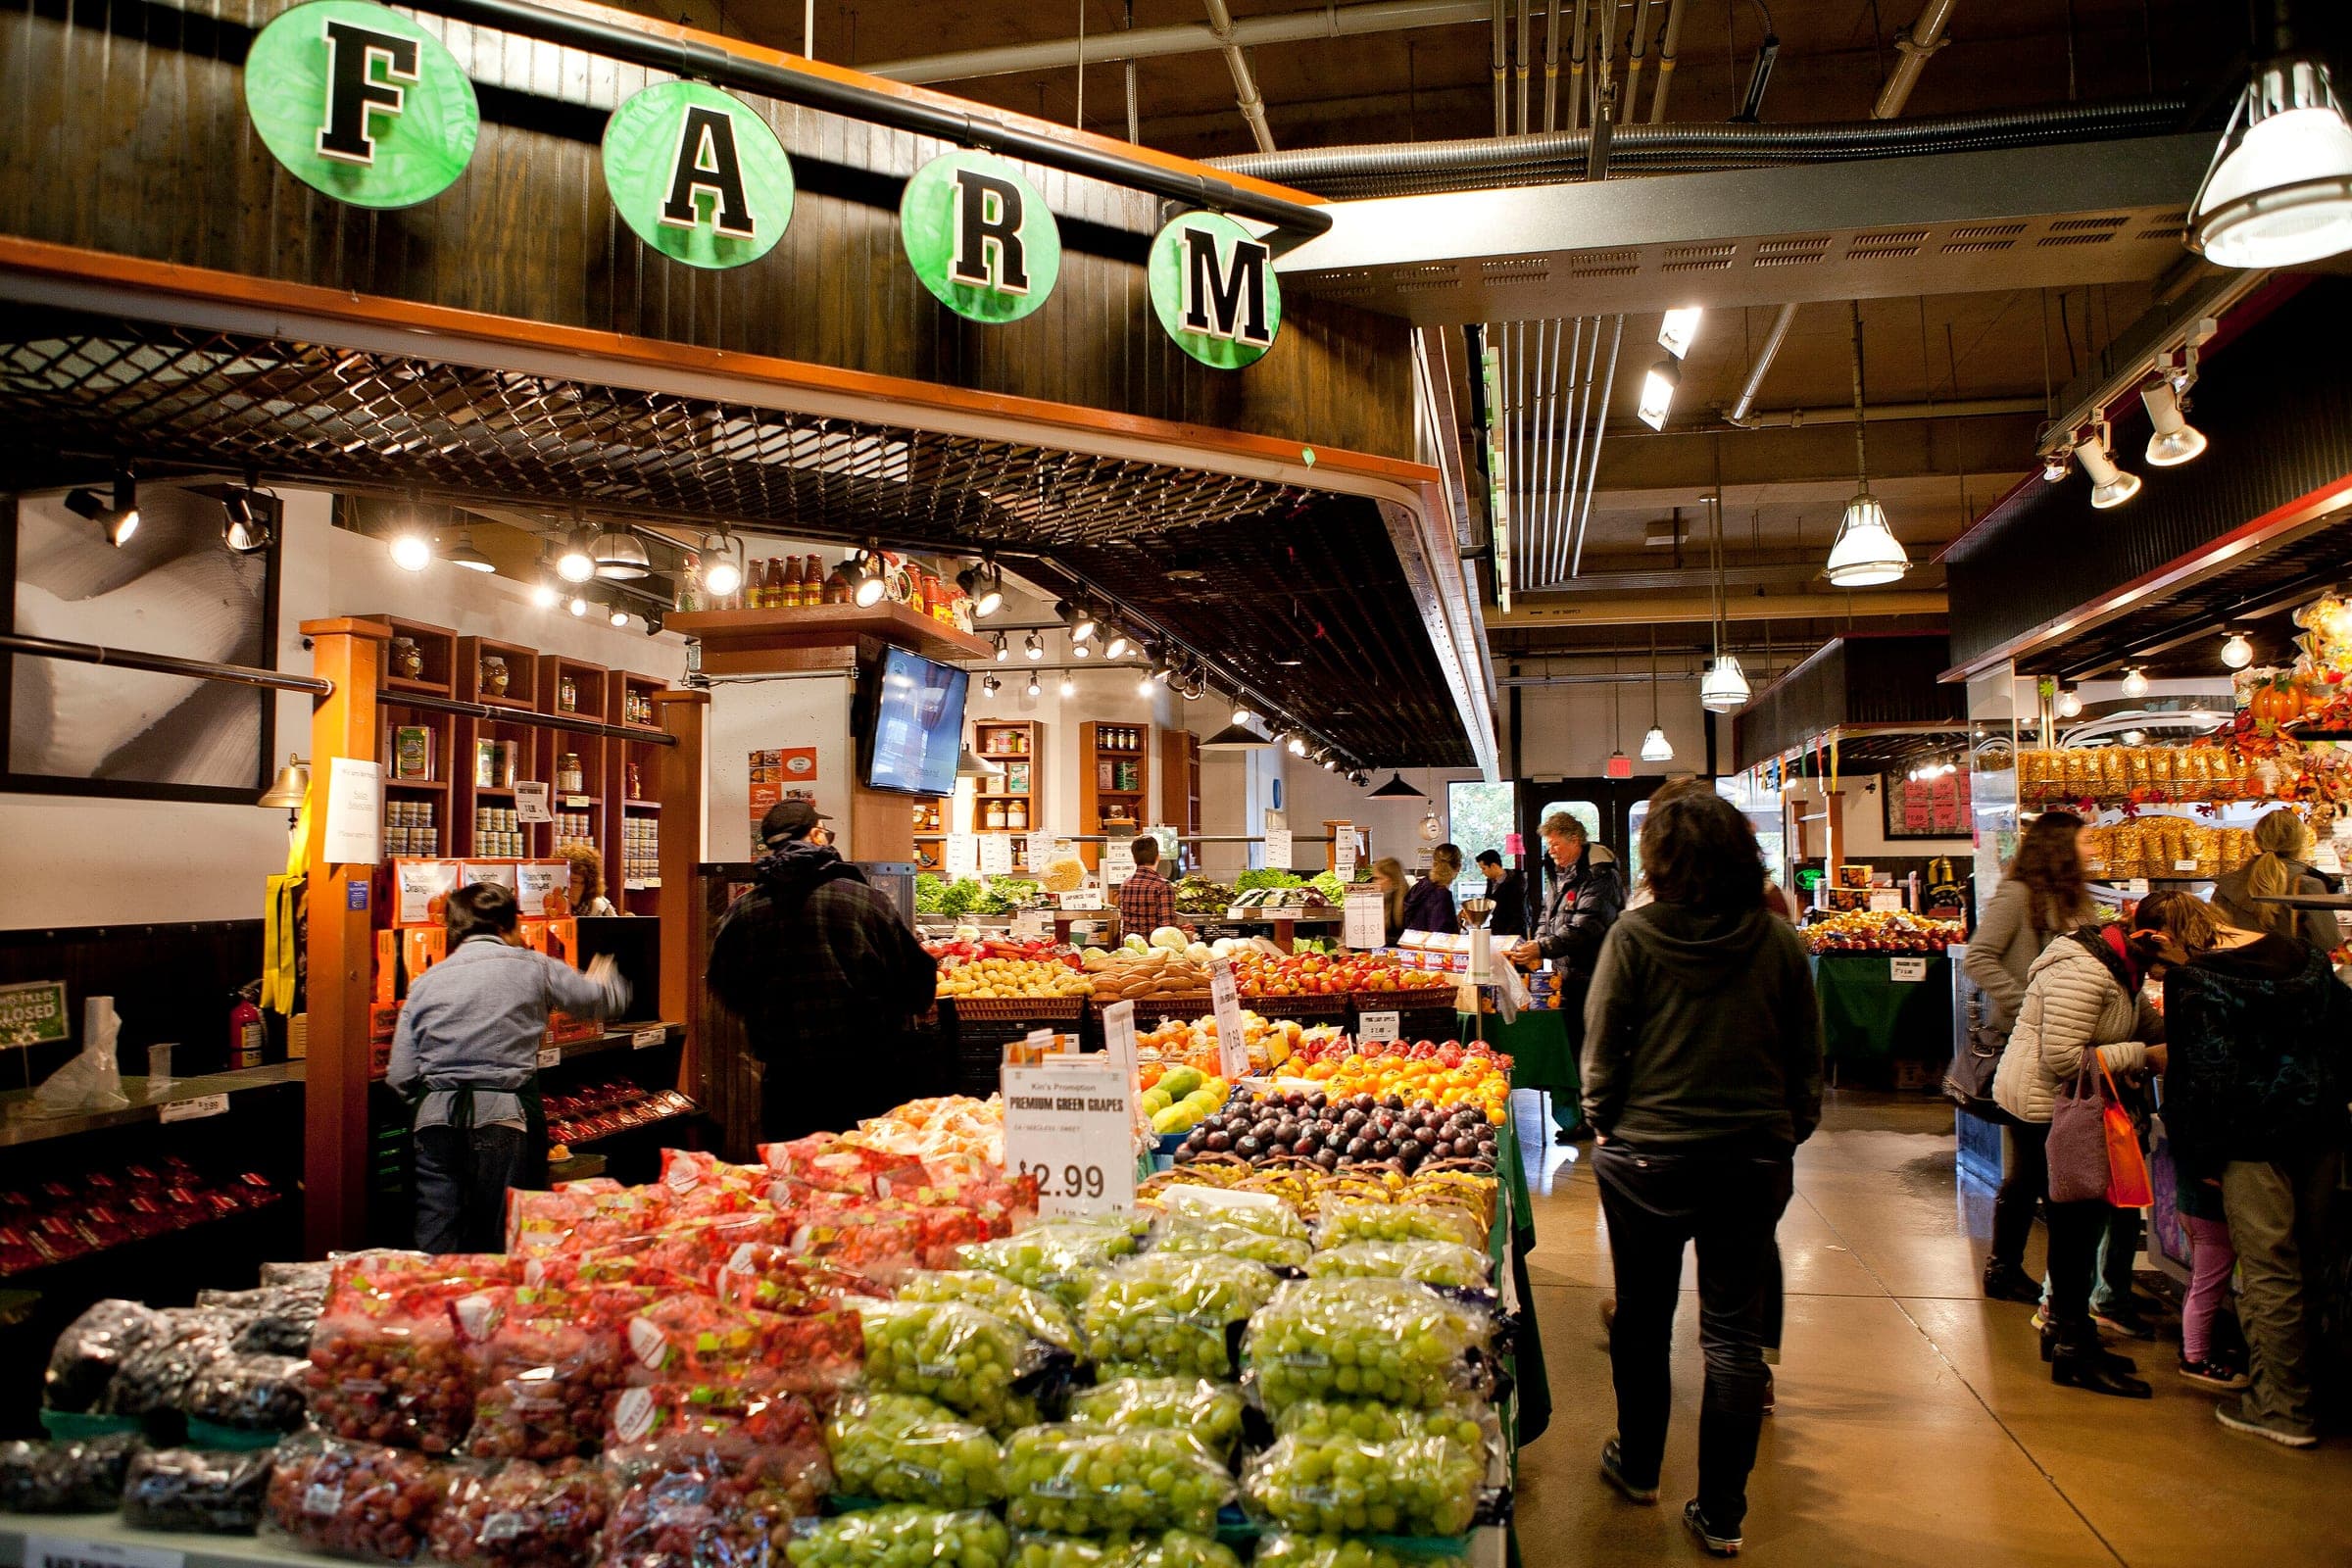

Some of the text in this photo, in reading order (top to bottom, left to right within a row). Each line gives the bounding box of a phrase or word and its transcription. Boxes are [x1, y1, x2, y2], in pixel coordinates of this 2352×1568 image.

[0, 1004, 56, 1024] LOSED
[1054, 1083, 1096, 1092] Promotion
[1009, 1097, 1124, 1112] PREMIUM GREEN GRAPES
